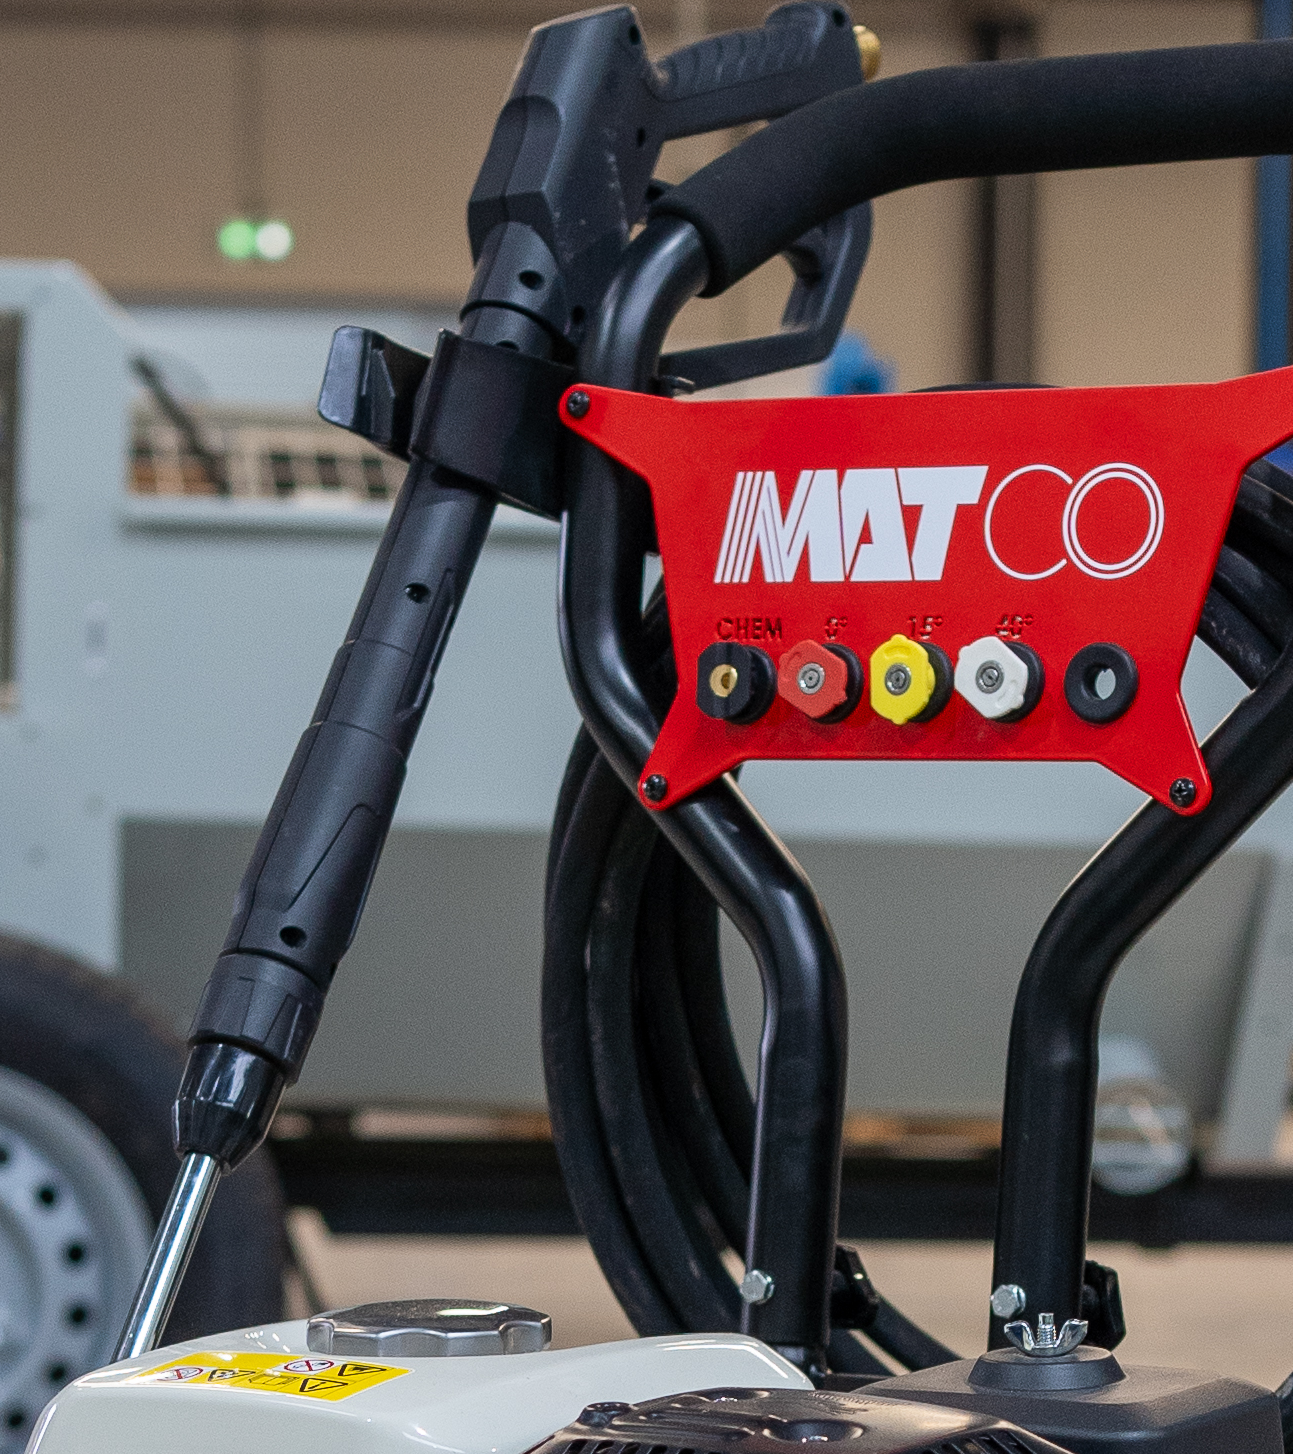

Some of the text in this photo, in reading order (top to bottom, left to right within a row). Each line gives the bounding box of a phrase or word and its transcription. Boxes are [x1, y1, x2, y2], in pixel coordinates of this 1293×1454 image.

[713, 462, 1165, 583] MATCO
[716, 614, 1033, 641] CHEM 0° 15° 40°
